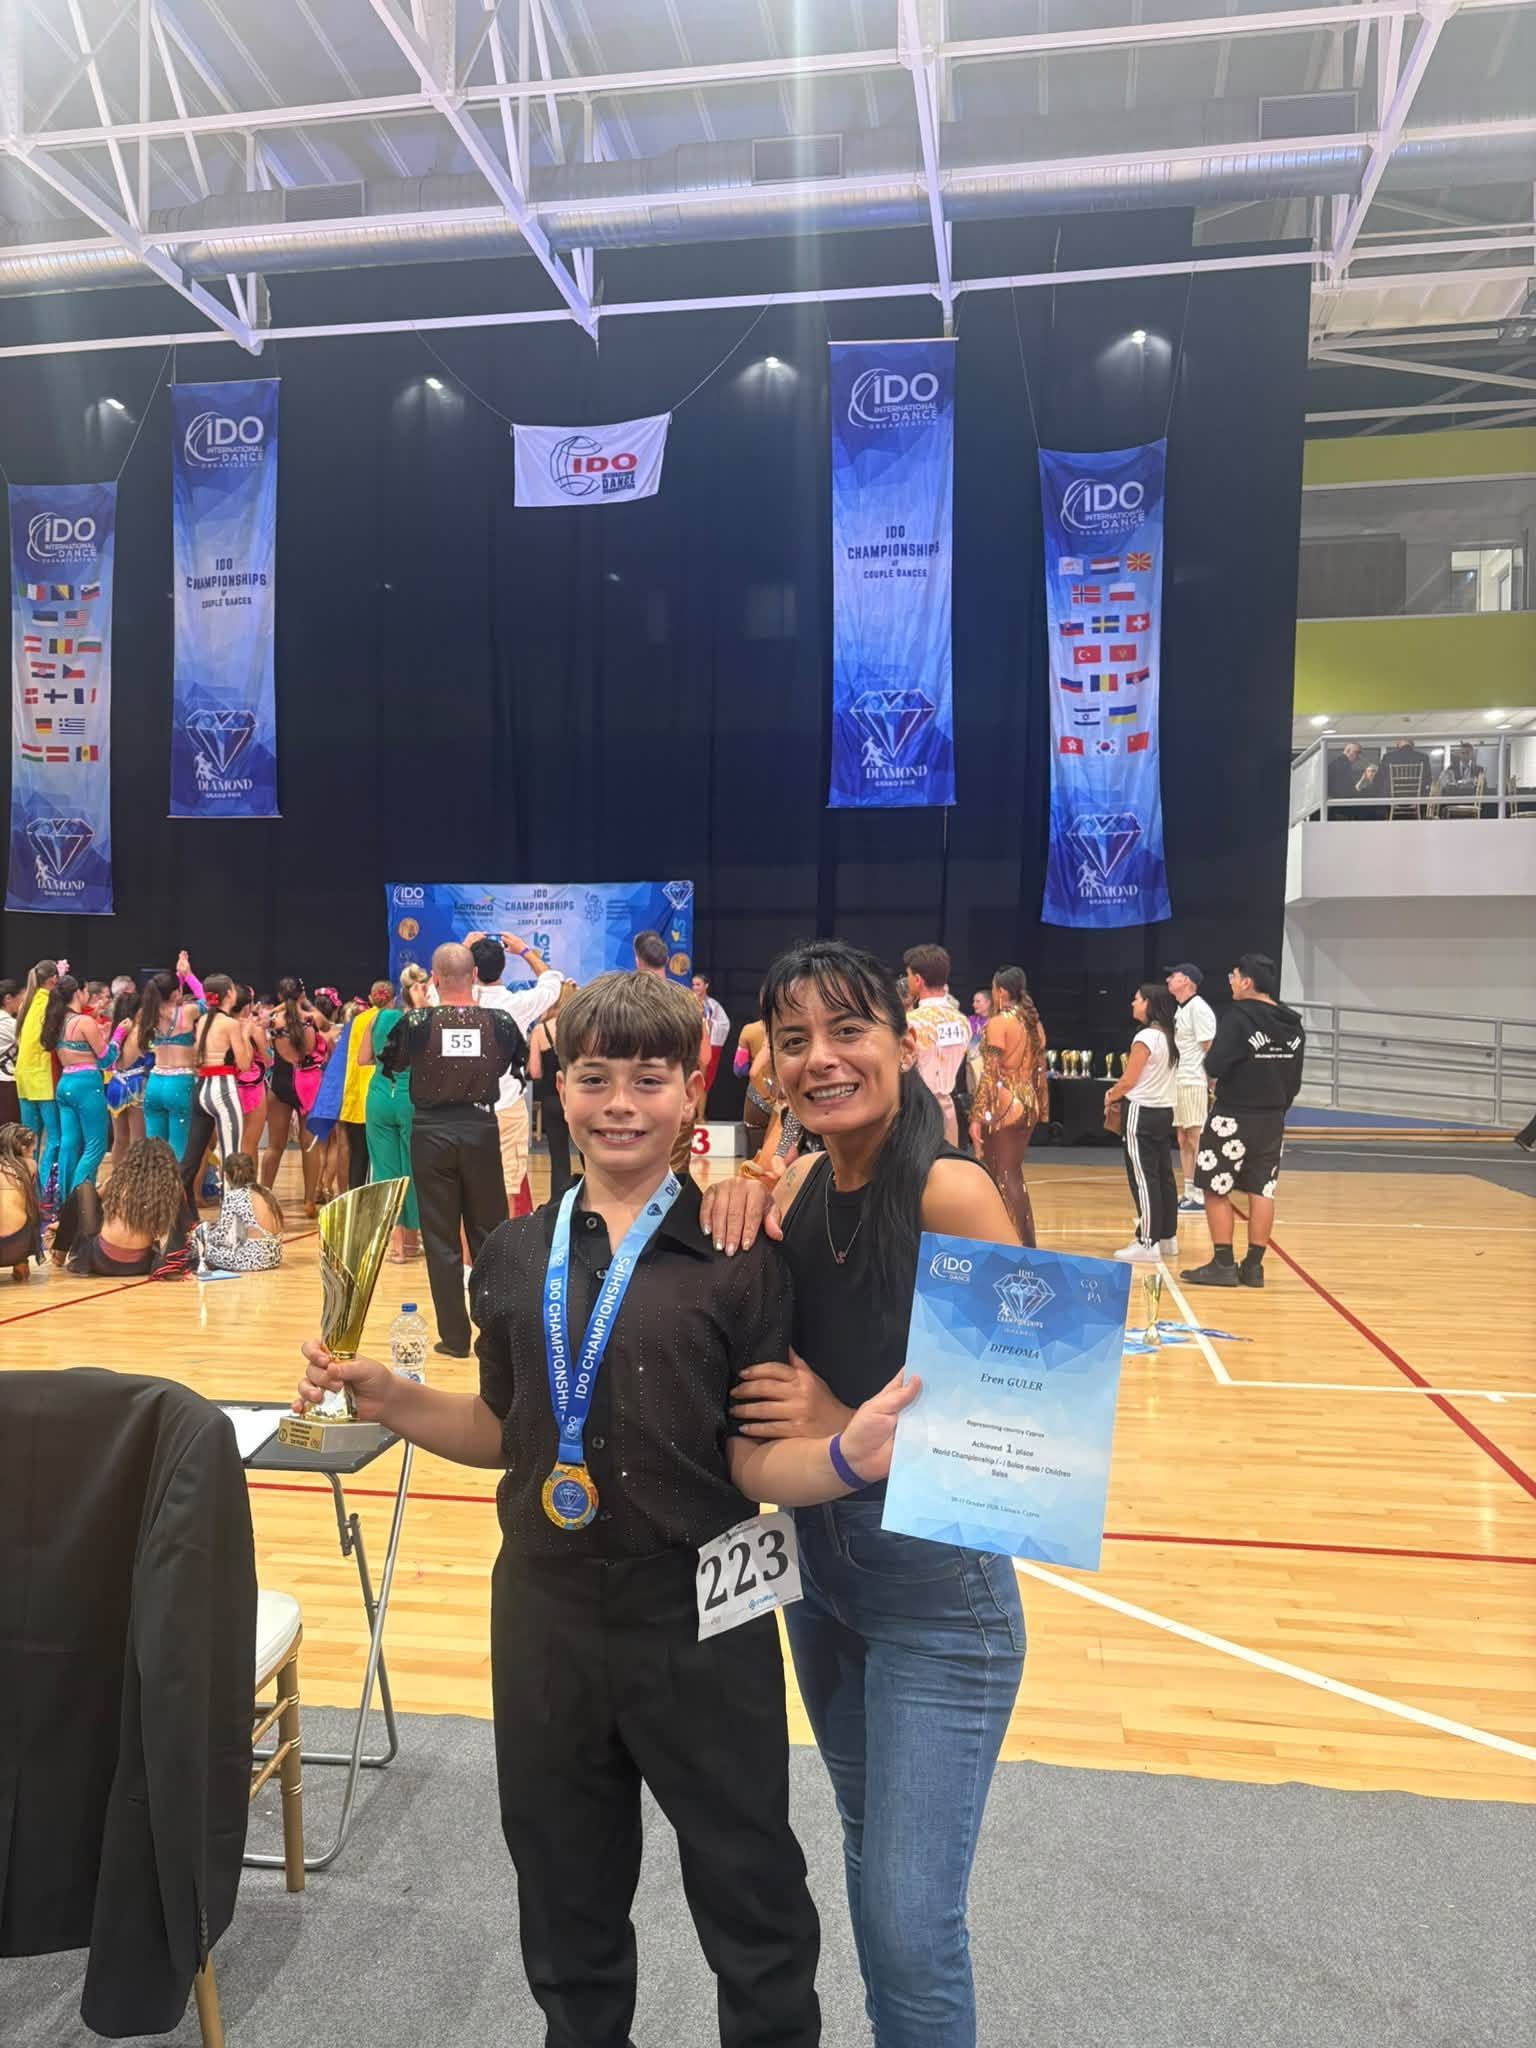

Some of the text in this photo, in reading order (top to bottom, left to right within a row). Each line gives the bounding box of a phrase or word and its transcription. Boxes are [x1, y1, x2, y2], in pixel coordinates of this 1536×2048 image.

[874, 402, 936, 414] INTERNATIONAL
[892, 410, 937, 422] DANCE
[222, 452, 264, 462] DANCE
[572, 453, 637, 474] IDO
[1101, 513, 1144, 529] DANCE
[886, 525, 906, 539] IDO
[58, 549, 96, 558] DANCE
[847, 541, 939, 559] CHAMPIONSHIPS
[215, 558, 232, 571] IDO
[864, 568, 927, 579] COUPLE DANCES
[186, 573, 267, 591] CHAMPIONSHIPS
[866, 765, 928, 779] DIAMOND
[198, 779, 253, 791] DIAMOND
[1080, 885, 1138, 897] DIAMOND
[505, 901, 575, 912] CHAMPIONSHIPS
[451, 1034, 473, 1048] 55
[691, 1128, 710, 1155] 3
[943, 1256, 973, 1273] IDO
[549, 1278, 562, 1300] IDO
[574, 1256, 631, 1399] IDO CHAMPIONSHIPS
[990, 1343, 1040, 1360] DIPLOMA
[980, 1372, 1043, 1392] Eren GULER
[971, 1440, 1034, 1458] Achieved 1 place
[932, 1447, 950, 1457] World
[952, 1450, 995, 1465] Championship
[1045, 1467, 1072, 1478] Children
[701, 1529, 789, 1612] 223
